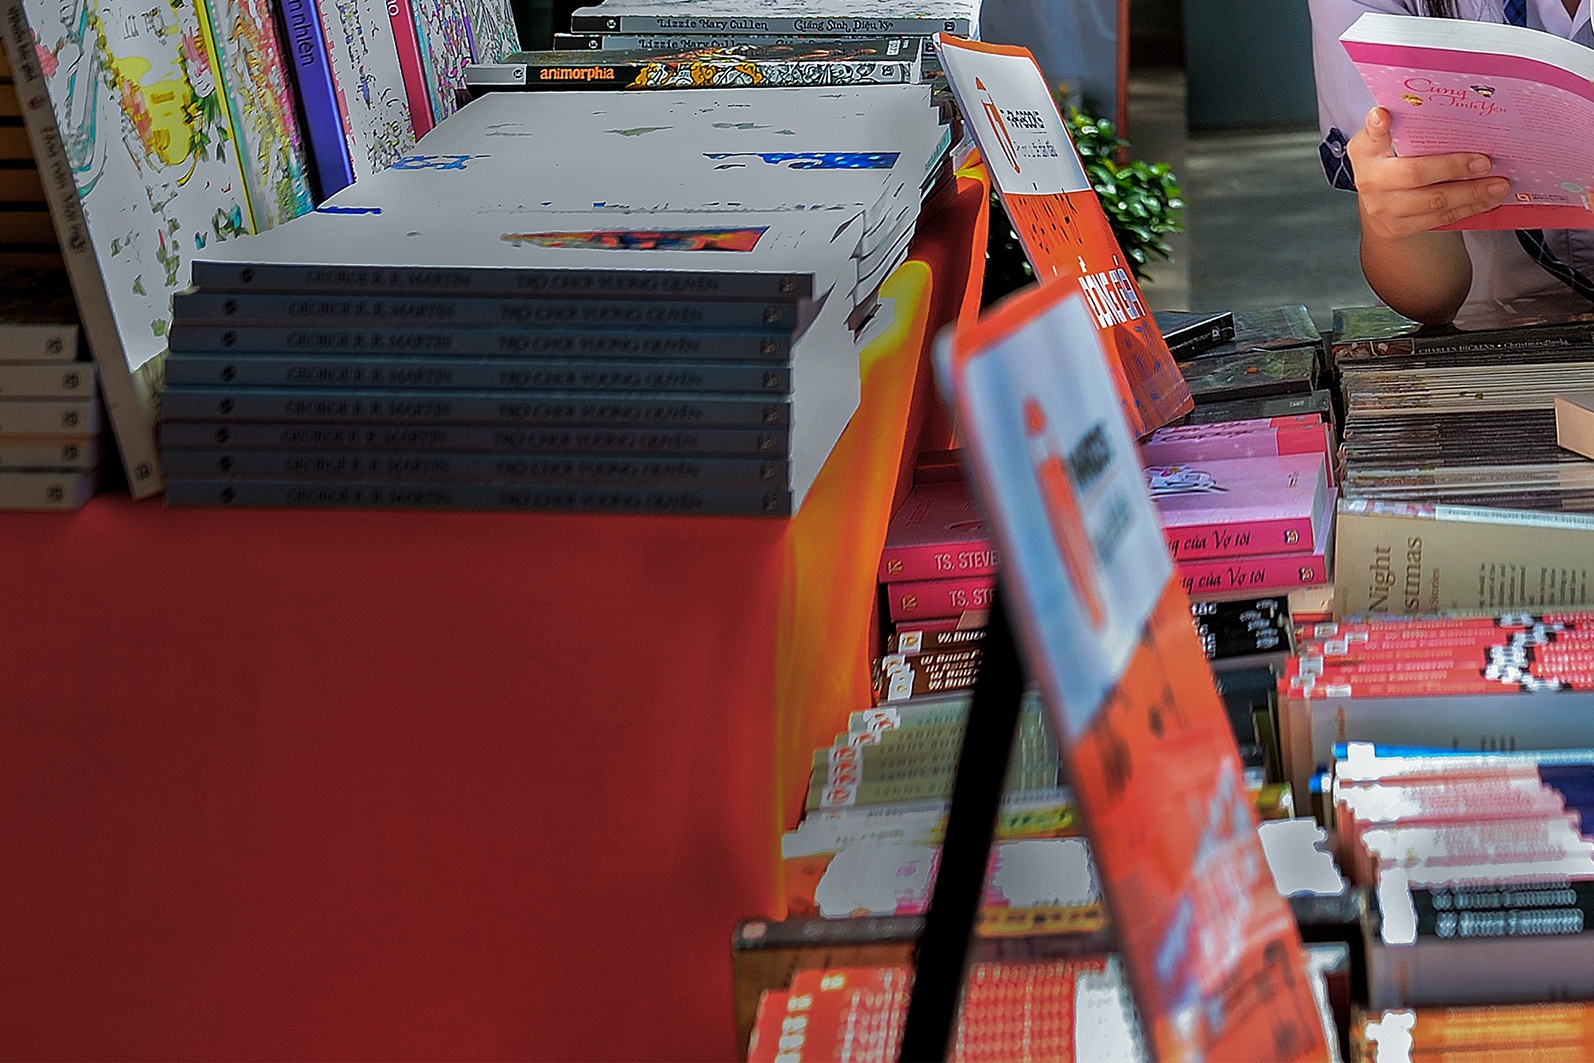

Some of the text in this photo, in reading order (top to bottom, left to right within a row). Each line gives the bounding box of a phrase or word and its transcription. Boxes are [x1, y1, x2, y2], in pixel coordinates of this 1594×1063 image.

[657, 18, 769, 33] Lizzie Mary Cullen
[638, 39, 679, 50] Lizzie
[539, 66, 615, 82] animorphia
[1403, 77, 1468, 101] Cung
[1418, 345, 1458, 356] CHARLES
[1459, 343, 1495, 353] DICKENS
[1184, 536, 1207, 551] của
[957, 548, 999, 571] STEVE
[1198, 574, 1222, 589] của
[1368, 544, 1396, 614] Night
[1403, 536, 1424, 615] stmas
[972, 587, 996, 606] STE
